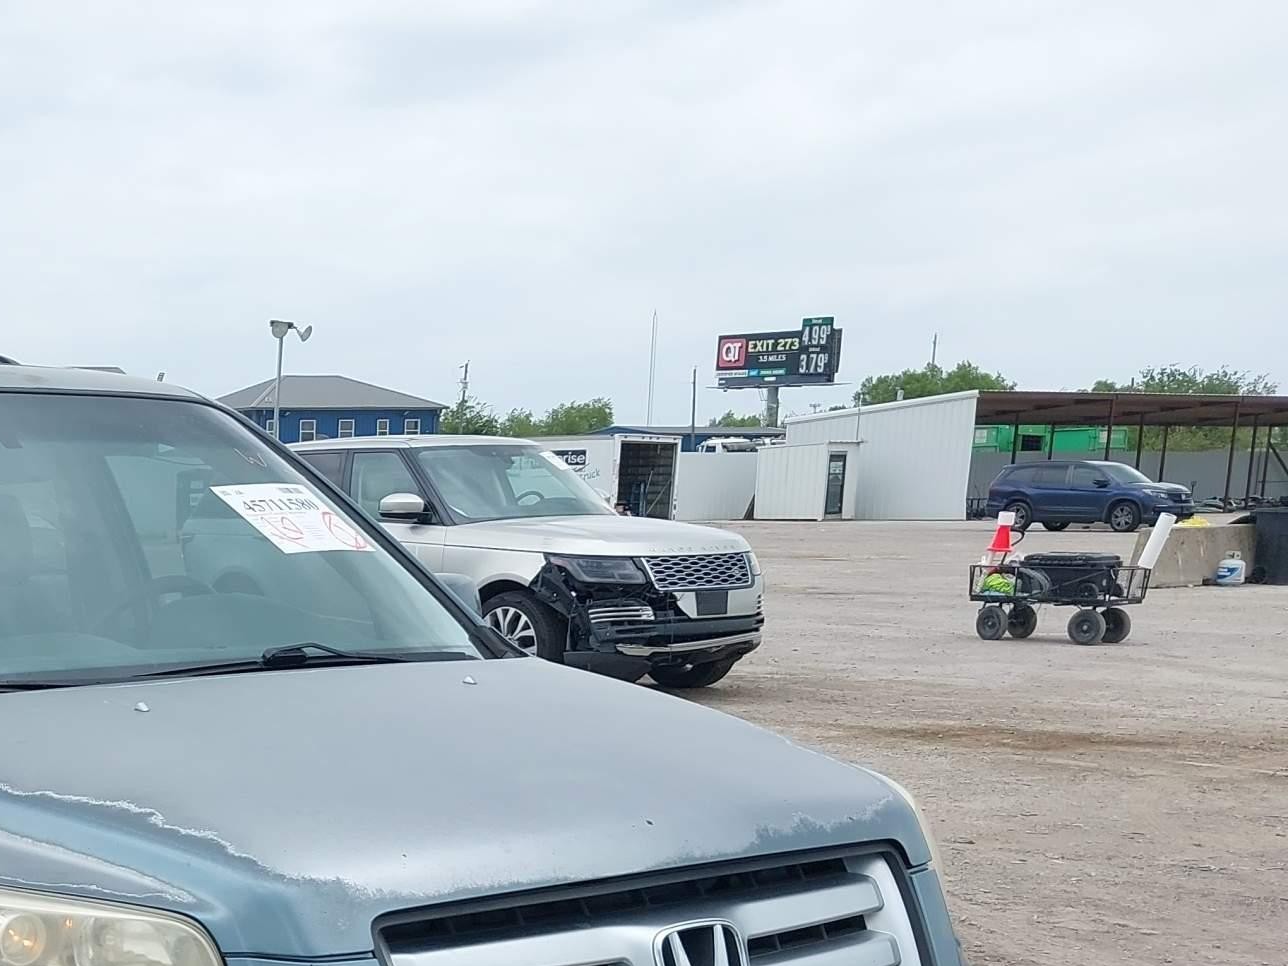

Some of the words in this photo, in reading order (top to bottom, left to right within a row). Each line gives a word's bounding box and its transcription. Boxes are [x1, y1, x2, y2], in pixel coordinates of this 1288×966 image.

[748, 340, 775, 352] EXIT
[777, 338, 799, 350] 273
[722, 343, 742, 362] QT
[242, 499, 320, 513] 45711580
